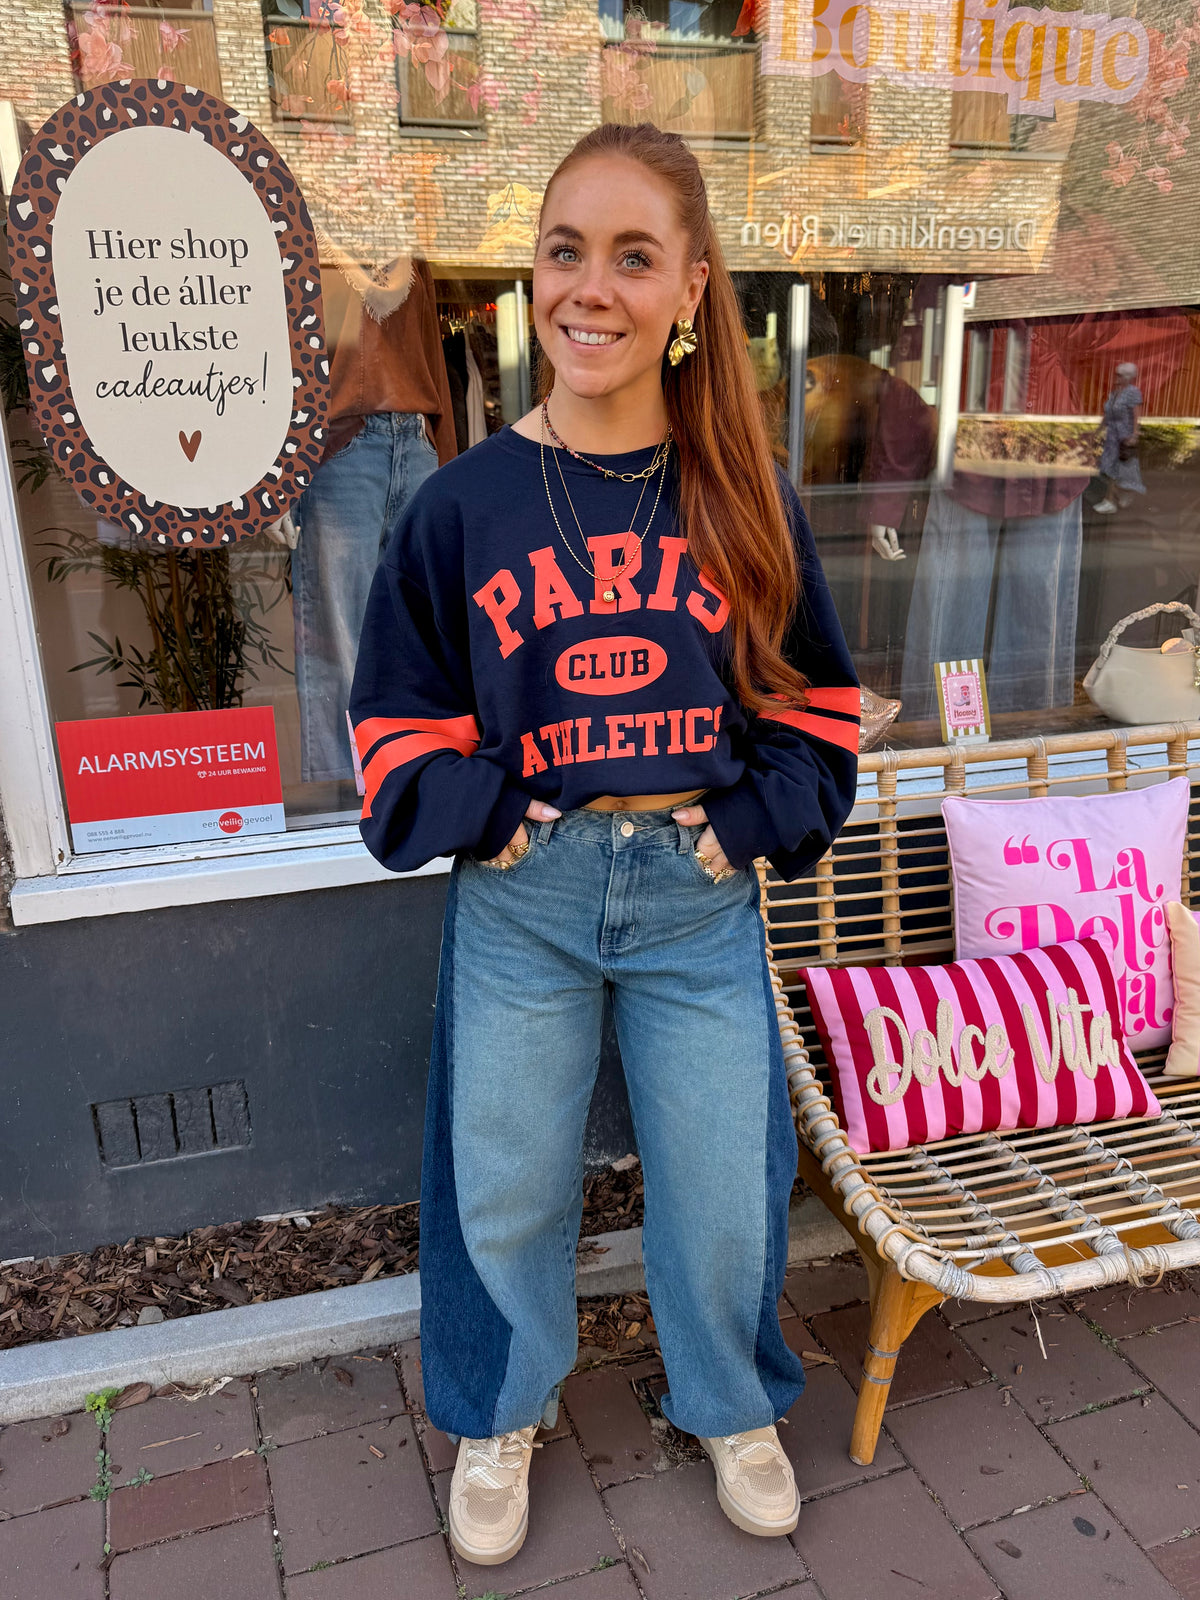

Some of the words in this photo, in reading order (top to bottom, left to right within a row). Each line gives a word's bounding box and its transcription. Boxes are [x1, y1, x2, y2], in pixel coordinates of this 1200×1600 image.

[776, 0, 1140, 100] Boutique
[85, 229, 161, 259] Hier
[170, 228, 249, 267] shop
[94, 277, 124, 316] je
[131, 275, 170, 306] de
[179, 275, 251, 305] áller
[118, 321, 239, 352] leukste
[95, 351, 268, 416] cadeautjes!
[472, 531, 731, 660] PARIS
[568, 648, 650, 681] CLUB
[77, 742, 265, 775] ALARMSYSTEEM
[232, 766, 266, 774] BEWAKING
[984, 893, 1170, 972] Dolc
[864, 998, 1015, 1105] Dolce
[1022, 987, 1120, 1083] Vita
